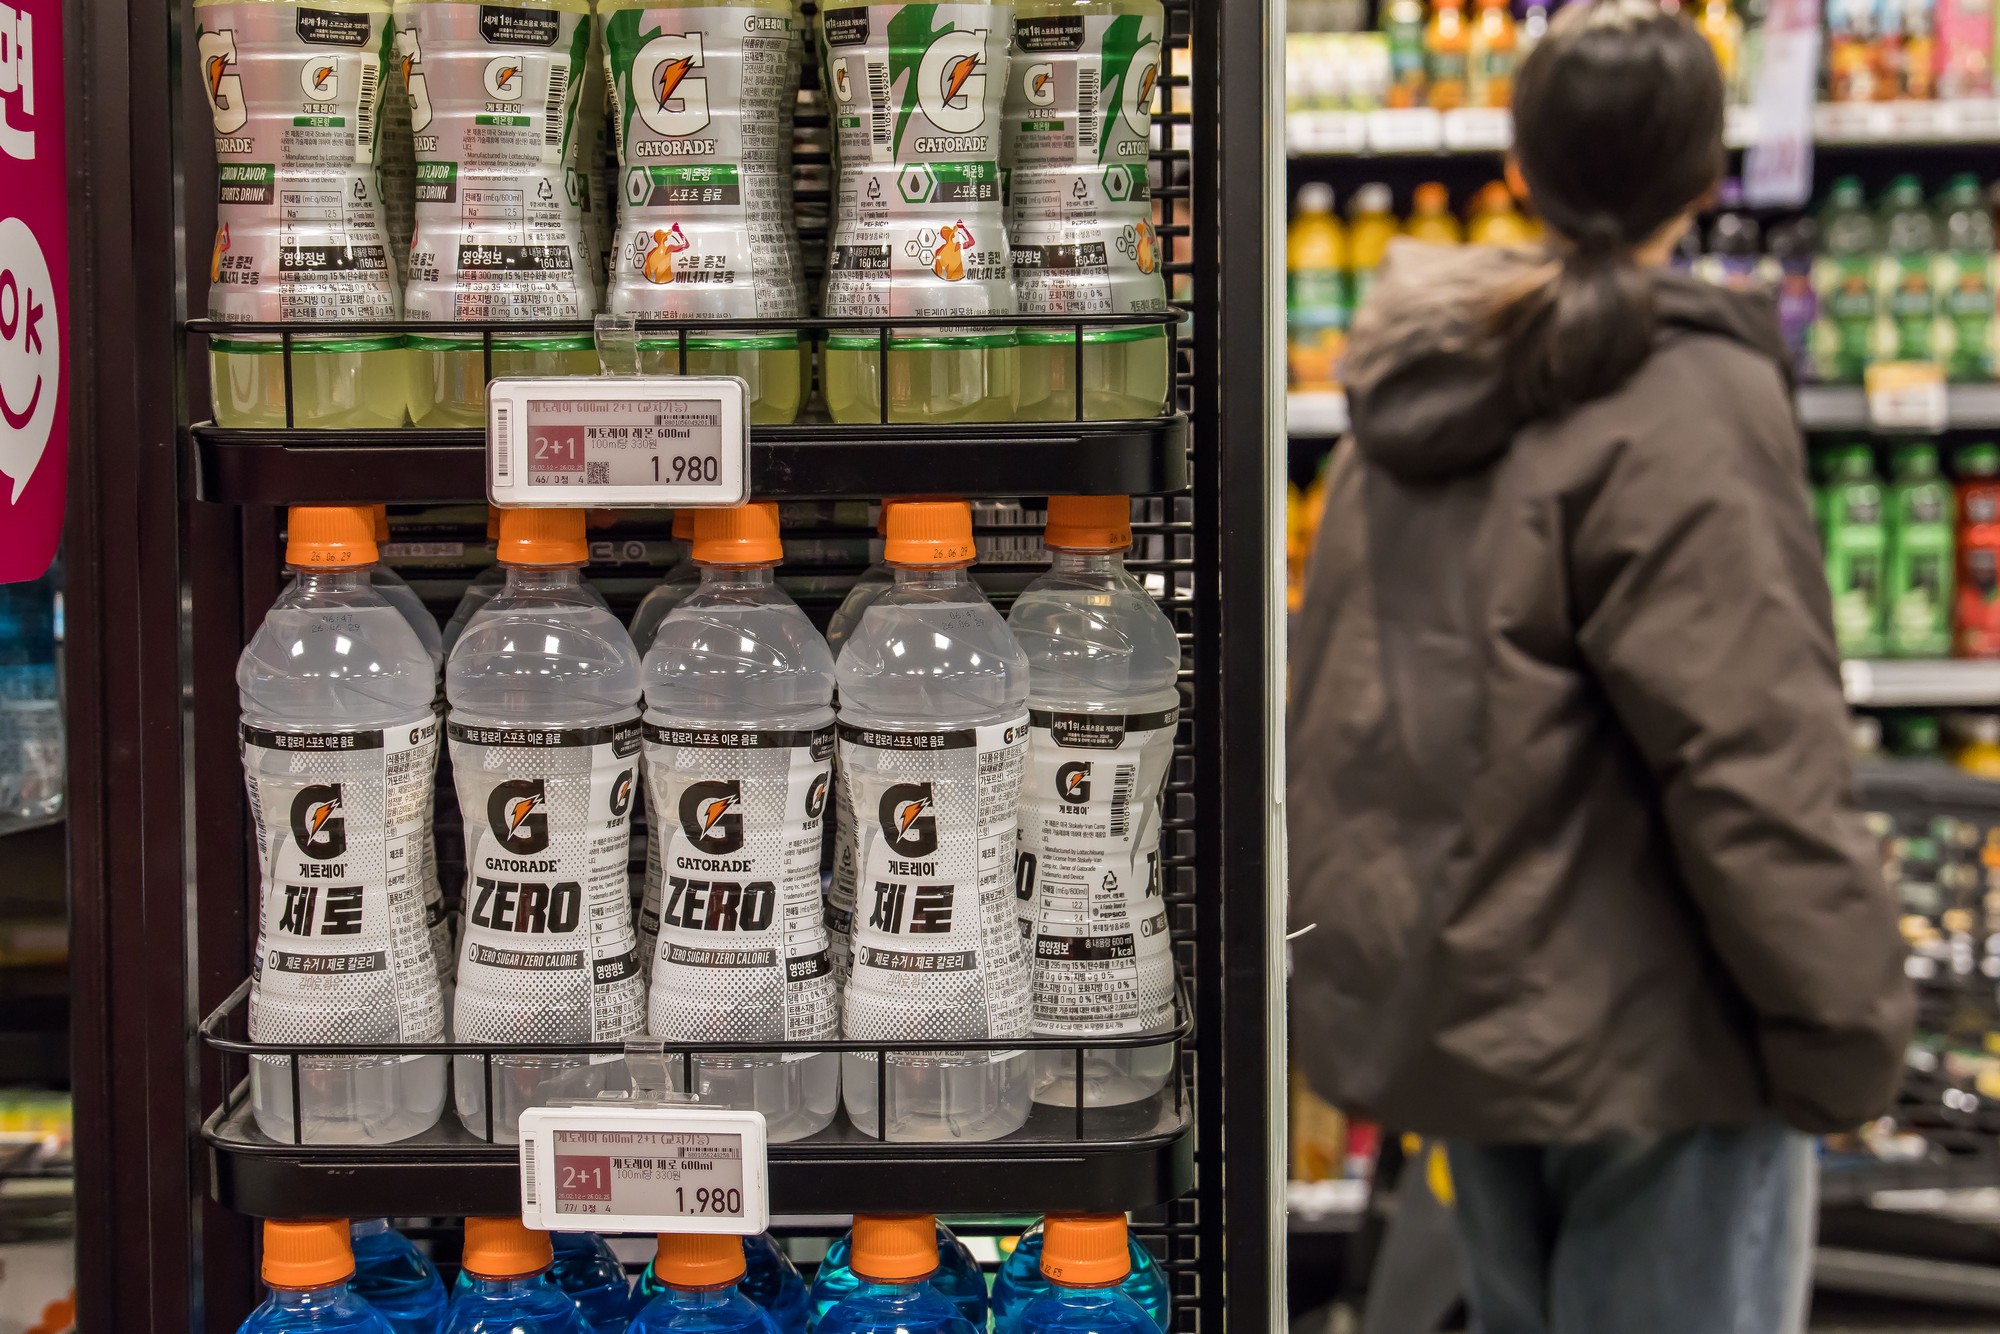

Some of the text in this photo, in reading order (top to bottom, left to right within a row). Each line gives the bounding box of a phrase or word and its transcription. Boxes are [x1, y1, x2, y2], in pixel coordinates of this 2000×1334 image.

[484, 16, 498, 26] 세계
[500, 14, 512, 26] 1위
[744, 16, 782, 32] G 게토레이
[744, 52, 764, 62] 원재료명
[300, 56, 338, 102] G
[483, 56, 524, 101] G
[631, 31, 711, 136] G
[916, 28, 988, 134] G
[1023, 62, 1056, 106] G
[302, 103, 337, 114] 게토레이
[486, 103, 522, 114] 게토레이
[1028, 109, 1056, 118] 게토레이
[310, 116, 330, 126] 레몬향
[492, 116, 514, 126] 레몬향
[635, 139, 715, 157] GATORADE
[914, 136, 987, 153] GATORADE
[236, 166, 266, 182] FLAVOR
[424, 164, 450, 179] FLAVOR
[681, 168, 712, 182] 레몬향
[962, 164, 984, 178] 레몬향
[240, 188, 265, 202] DRINK
[426, 184, 447, 200] DRINK
[669, 188, 722, 202] 스포츠 음료
[952, 184, 992, 198] 스포츠 음료
[284, 252, 326, 266] 영양정보
[462, 251, 502, 266] 영양정보
[678, 255, 726, 269] 수분 충전
[858, 258, 889, 268] 160 kcal
[240, 271, 260, 285] 보충
[675, 270, 736, 284] 에너지 보충
[456, 294, 492, 304] 트랜스지방
[512, 294, 541, 304] 포화지방
[1048, 290, 1075, 300] 포화지방
[532, 306, 552, 316] 단백질
[1066, 300, 1086, 310] 단백질
[530, 402, 572, 413] 게토레이
[576, 402, 609, 412] 600ml
[613, 402, 632, 412] 2+1
[586, 428, 690, 439] 게토레이 레몬 600ml
[534, 436, 576, 460] 2+1
[591, 439, 658, 450] 100ml당 330원
[651, 456, 718, 484] 1,980
[535, 475, 550, 484] 46/
[578, 476, 584, 484] 4
[1054, 722, 1067, 731] 세계
[1068, 721, 1080, 731] 1위
[275, 734, 354, 748] 제로 칼로리 스포츠 이온 음료
[466, 730, 561, 745] 제로 칼로리 스포츠 이온 음료
[658, 730, 758, 746] 제로 칼로리 스포츠 이온 음료
[863, 732, 945, 748] 제로 칼로리 스포츠 이온 음료
[387, 752, 412, 764] 식품유형
[980, 752, 1004, 764] 식품유형
[1056, 761, 1092, 804] G
[610, 767, 633, 817] G
[804, 771, 829, 819] G
[486, 778, 550, 856] G
[1058, 804, 1088, 816] 게토레이
[290, 782, 347, 860] G
[678, 780, 744, 856] G
[878, 781, 938, 859] G
[485, 858, 558, 874] GATORADE
[676, 856, 752, 873] GATORADE
[888, 860, 935, 878] 게토레이
[299, 864, 345, 880] 게토레이
[279, 885, 364, 936] 제로
[471, 876, 582, 934] ZERO
[664, 875, 776, 932] ZERO
[869, 880, 954, 934] 제로
[1100, 910, 1126, 918] PEPSICO
[1038, 942, 1070, 956] 영양정보
[1085, 936, 1132, 948] 총 내용량 600 ml
[480, 949, 578, 968] ZERO SUGAR ZERO CALORIE
[672, 947, 770, 965] ZERO SUGAR ZERO CALORIE
[1110, 945, 1134, 958] 7 kcal
[285, 954, 376, 970] 제로 슈거 제로 칼로리
[789, 959, 818, 977] 영양정보
[874, 954, 965, 968] 제로 슈거 제로 칼로리
[1088, 960, 1110, 970] 탄수화물
[596, 962, 625, 978] 영양정보
[1034, 982, 1061, 992] 트랜스지방
[1078, 982, 1103, 992] 포화지방
[1095, 994, 1112, 1003] 단백질
[558, 1132, 598, 1144] 게토레이
[602, 1133, 634, 1144] 600ml
[637, 1134, 656, 1144] 2+1
[612, 1159, 713, 1170] 게토레이 제로 600ml
[562, 1166, 601, 1188] 2+1
[617, 1170, 681, 1181] 100ml당 330원
[675, 1186, 741, 1214] 1,980
[564, 1203, 578, 1212] 77/
[605, 1204, 611, 1212] 4
